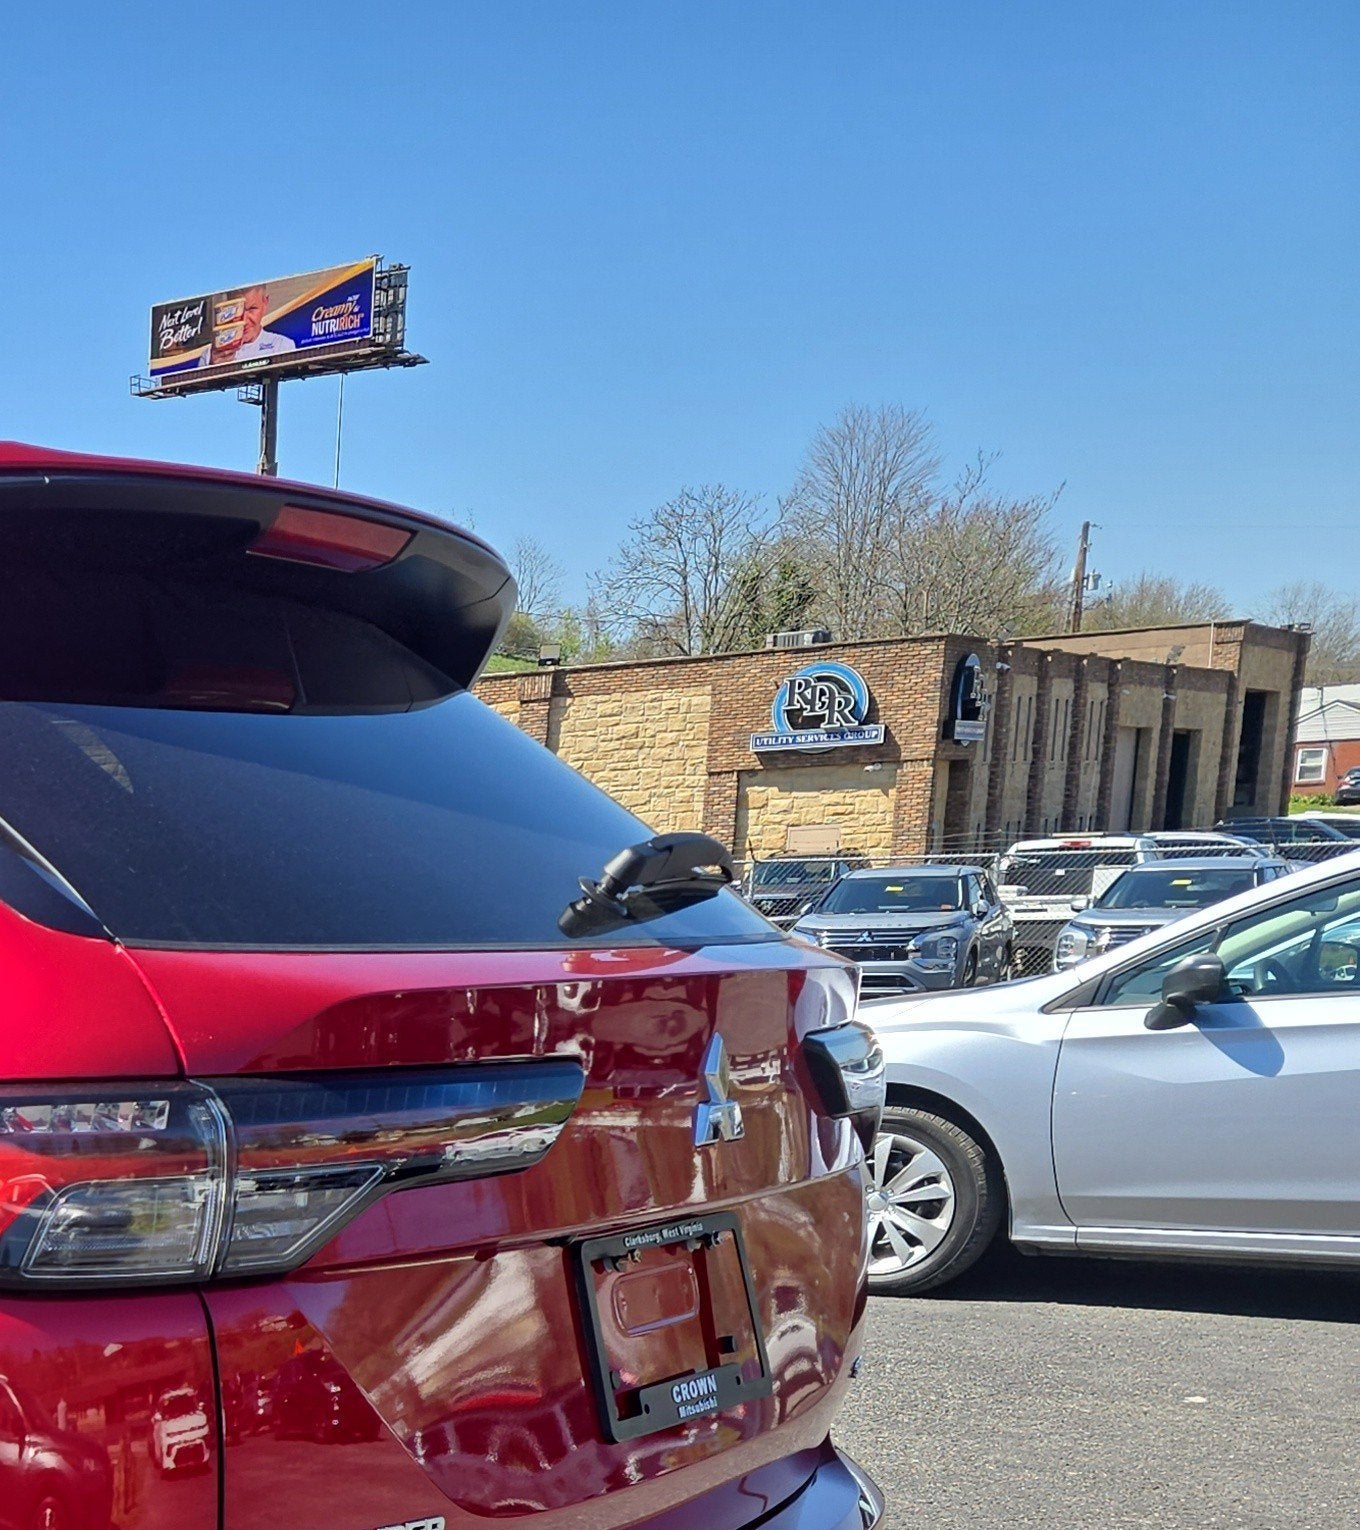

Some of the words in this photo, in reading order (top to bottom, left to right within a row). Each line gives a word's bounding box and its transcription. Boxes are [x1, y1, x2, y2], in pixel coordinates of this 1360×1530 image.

[311, 300, 357, 322] Creamy
[311, 314, 361, 337] NUTRIRICH
[755, 736, 794, 747] UTILITY
[795, 732, 841, 744] SERVICES
[843, 729, 879, 741] GROUP
[661, 1226, 679, 1239] West
[679, 1222, 703, 1236] Virginia
[672, 1374, 717, 1403] CROWN
[679, 1396, 718, 1418] Mitsubishi
